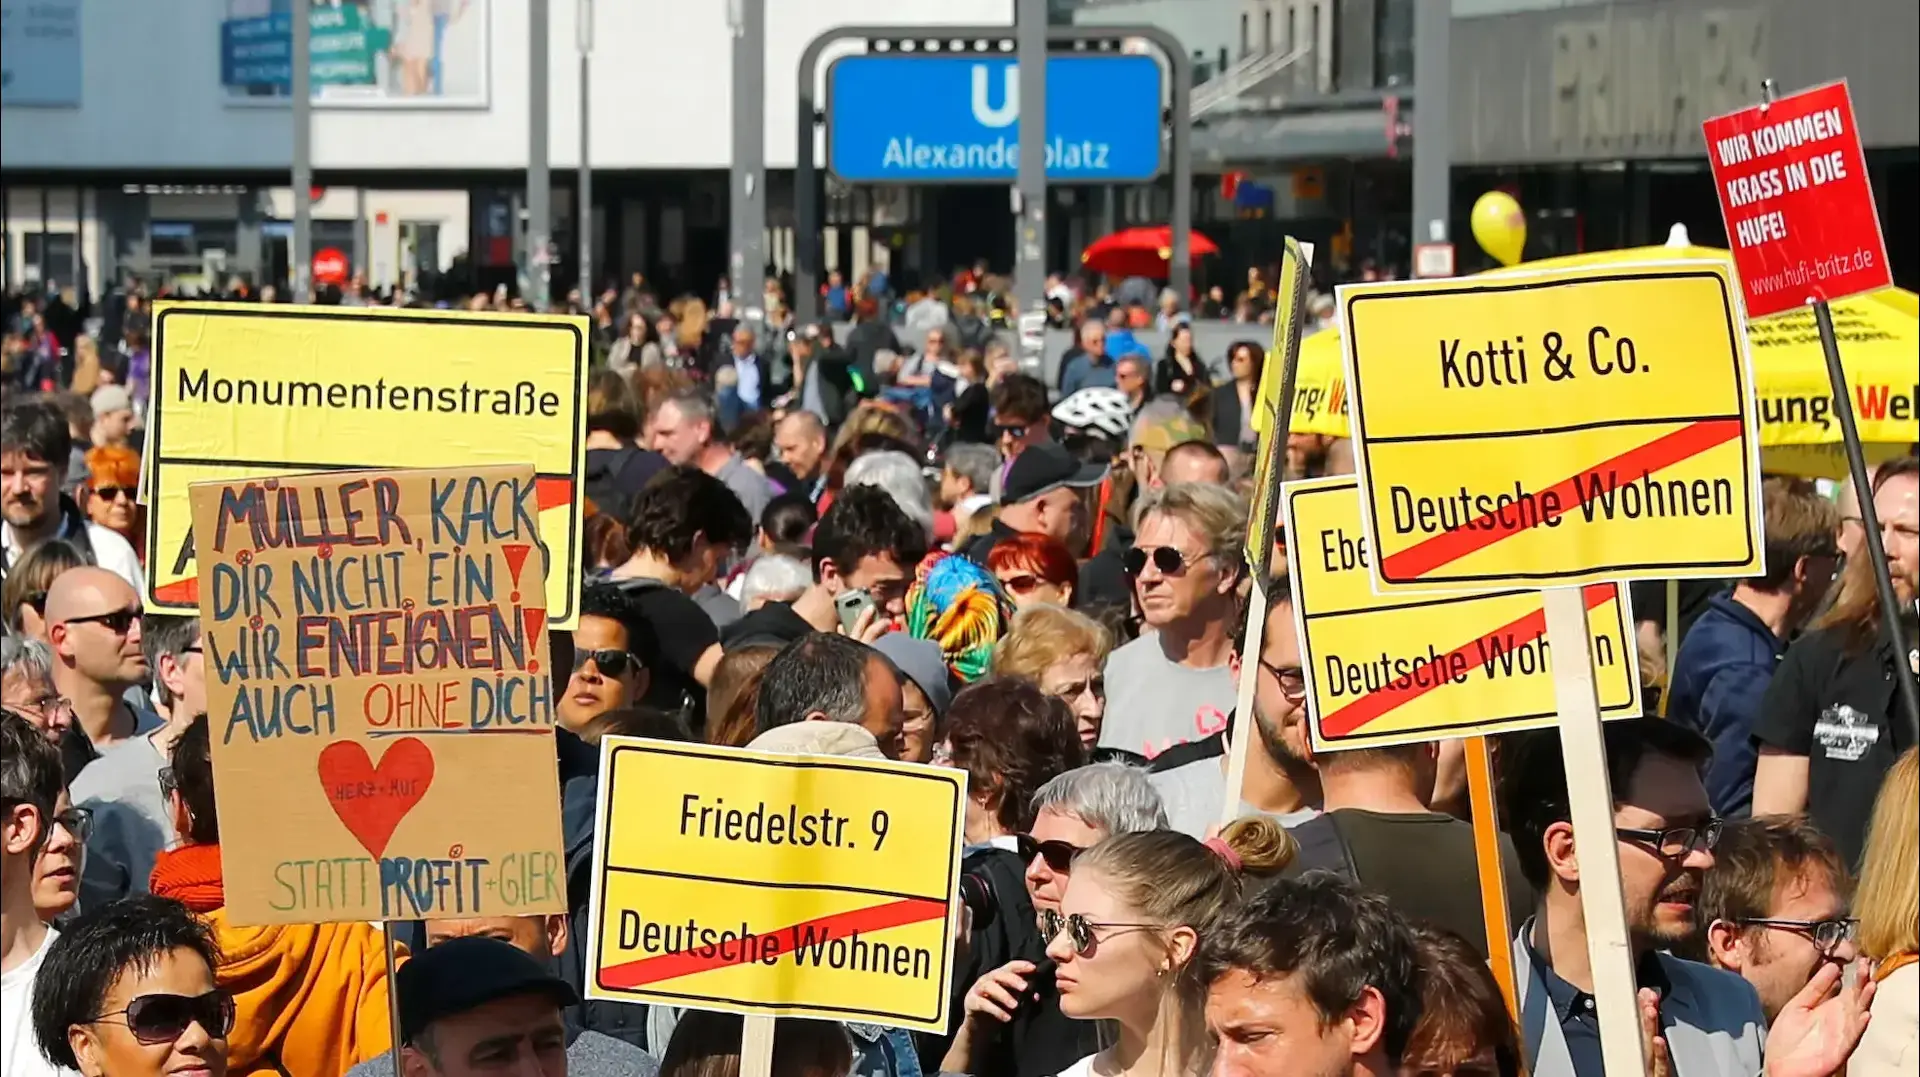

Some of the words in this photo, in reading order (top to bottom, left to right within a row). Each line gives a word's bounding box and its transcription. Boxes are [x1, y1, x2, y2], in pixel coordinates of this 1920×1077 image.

[882, 135, 1110, 170] Alexandelatz
[1717, 133, 1752, 167] WIR
[1752, 106, 1843, 158] KOMMEN
[1726, 168, 1783, 208] KRASS
[1784, 161, 1808, 192] IN
[1809, 150, 1847, 186] DIE
[1736, 210, 1787, 248] HUFE!
[1750, 246, 1874, 296] www.hufi-britz.de
[1440, 334, 1528, 389] Kotti
[1542, 331, 1576, 382] &
[1588, 325, 1650, 376] Co.
[178, 367, 560, 418] Monumentenstraße
[212, 476, 423, 554] MÜLLER,
[430, 475, 539, 548] KACK
[1391, 480, 1562, 534] Deutsche
[1573, 469, 1734, 525] Wohnen
[212, 549, 282, 621] DIR
[292, 545, 406, 617] NICHT
[208, 615, 291, 685] WIR
[1325, 644, 1468, 697] Deutsche
[1476, 630, 1614, 680] Wohn
[223, 682, 336, 745] AUCH
[363, 681, 463, 729] OHNE
[471, 673, 550, 729] DICH
[680, 793, 856, 849] Friedelstr.
[871, 809, 890, 851] 9
[268, 857, 372, 911] STATT
[619, 908, 780, 966] Deutsche
[792, 924, 931, 980] Wohnen
